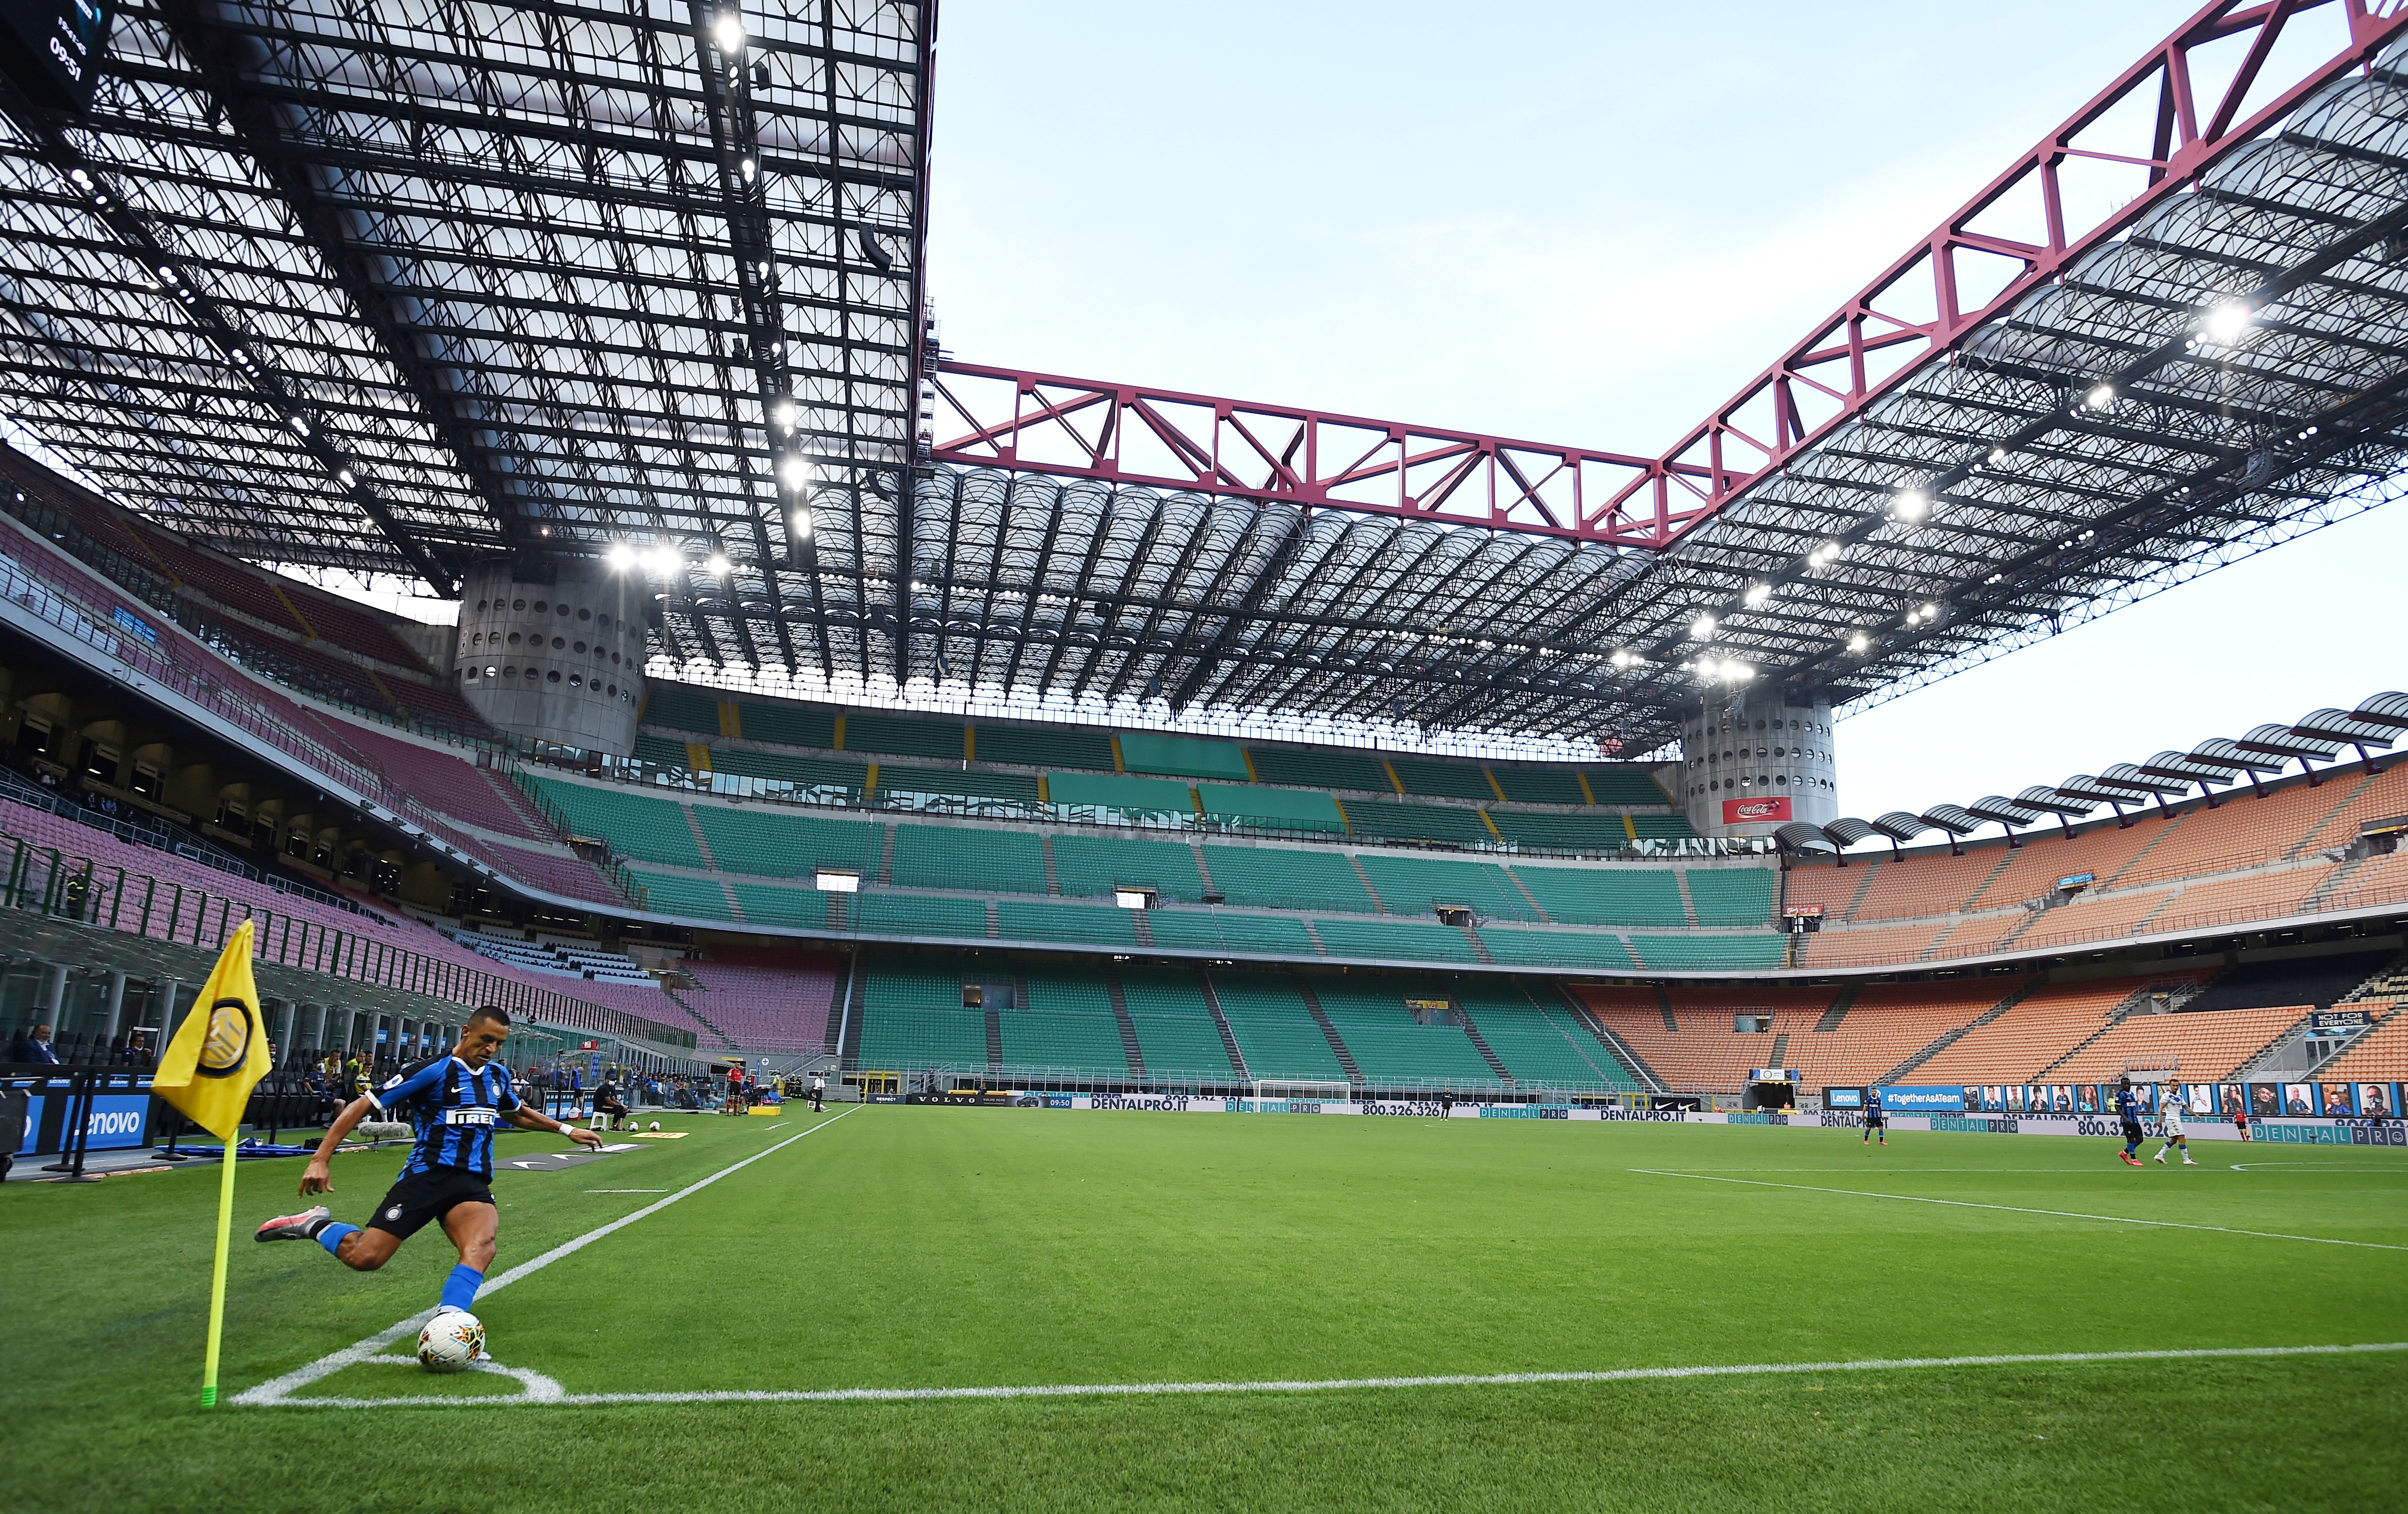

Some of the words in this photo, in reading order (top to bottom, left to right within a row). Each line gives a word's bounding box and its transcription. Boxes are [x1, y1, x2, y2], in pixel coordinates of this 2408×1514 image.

[50, 36, 82, 81] 09:51
[1832, 1093, 1858, 1103] Lenovo
[1888, 1093, 1960, 1105] #TogetherAsATeam
[1091, 1098, 1188, 1111] DENTALPRO.IT
[1362, 1105, 1440, 1116] 800.326.326
[446, 1107, 500, 1125] PIREL
[1601, 1110, 1686, 1122] DENTALPRO.IT
